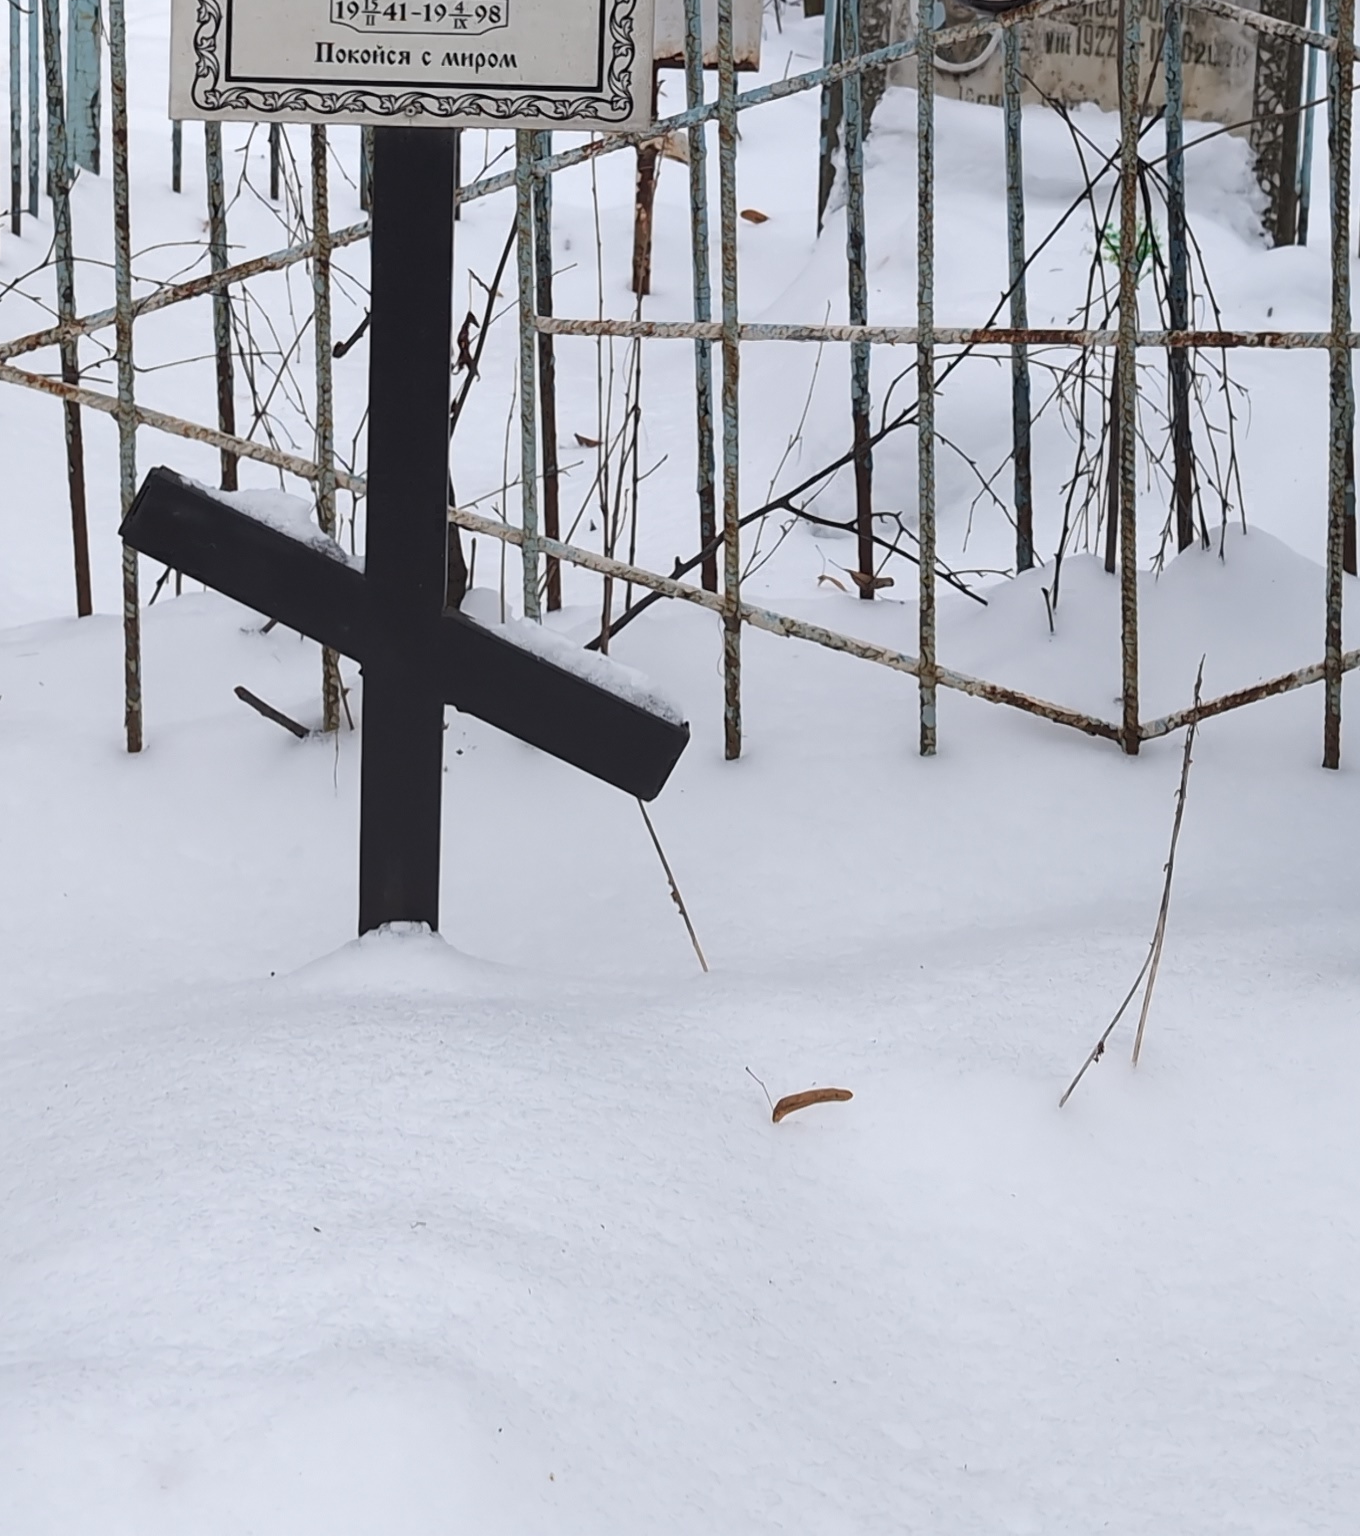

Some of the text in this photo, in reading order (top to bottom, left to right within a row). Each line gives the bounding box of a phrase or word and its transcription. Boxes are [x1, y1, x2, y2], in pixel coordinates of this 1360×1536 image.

[314, 41, 518, 74] Покойся с миром
